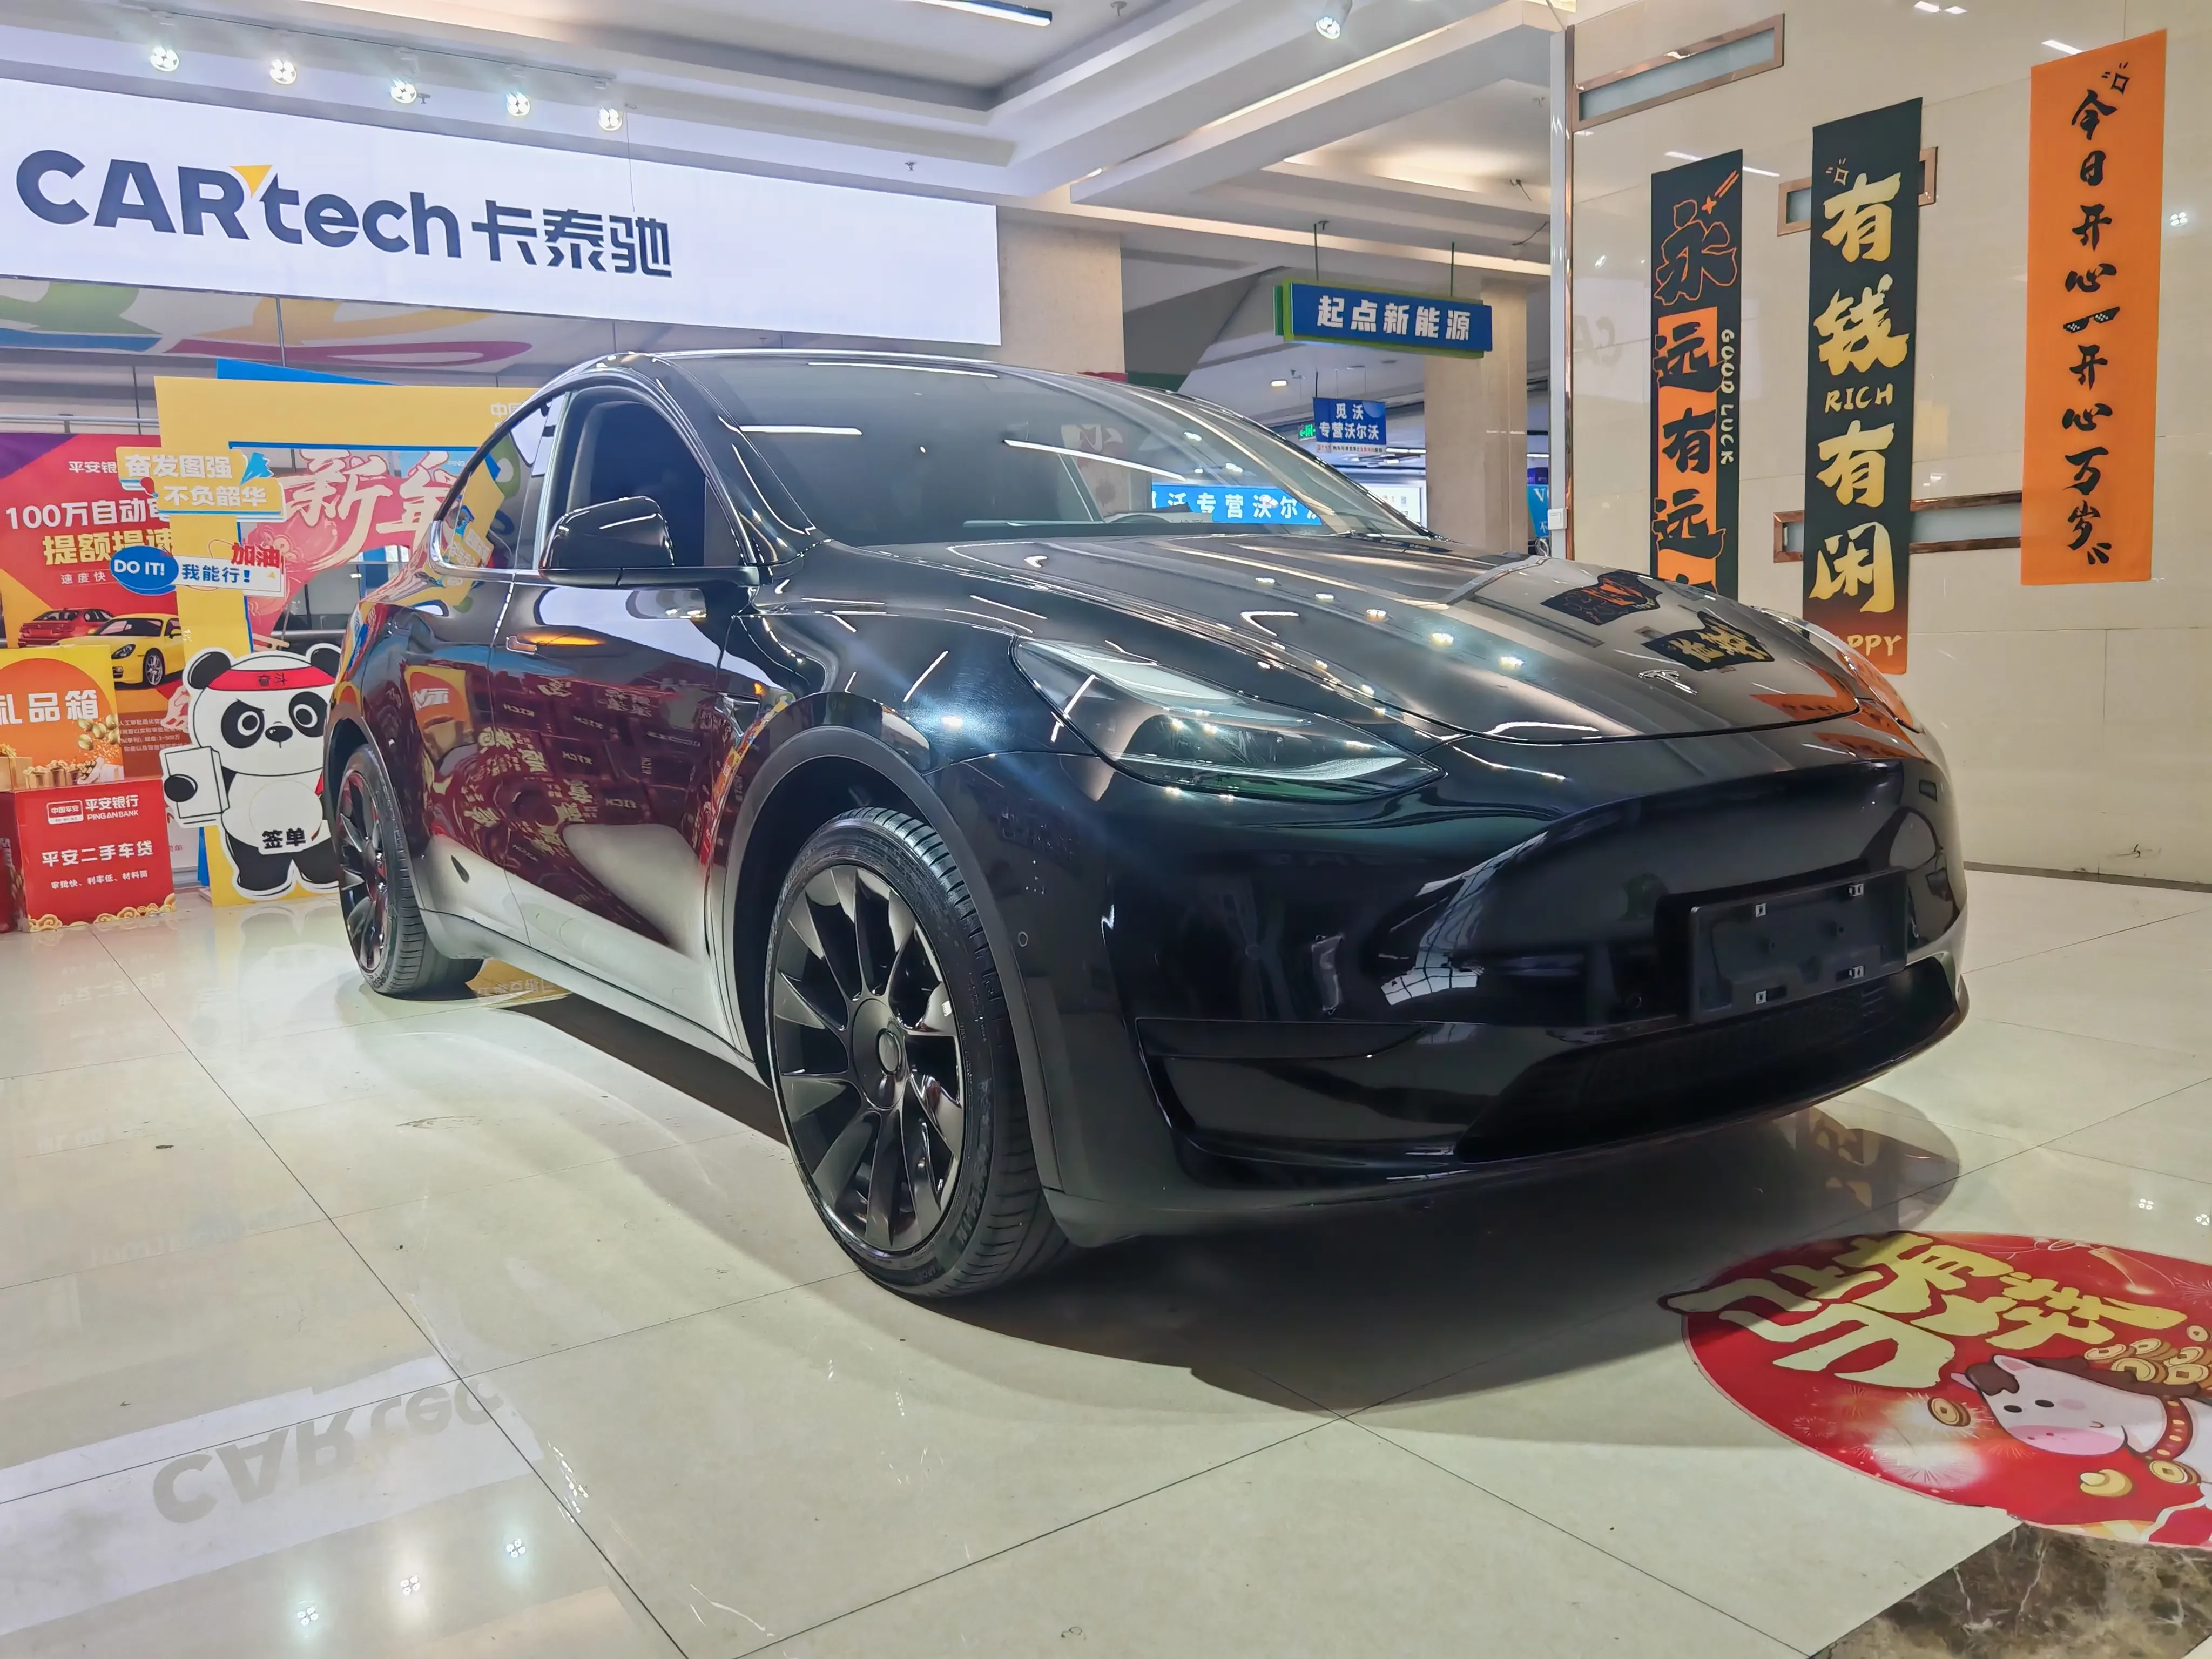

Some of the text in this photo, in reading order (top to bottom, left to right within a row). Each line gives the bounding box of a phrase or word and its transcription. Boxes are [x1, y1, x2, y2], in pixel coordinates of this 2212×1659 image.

[16, 149, 672, 278] CARtech 卡泰驰
[1813, 172, 1910, 376] 有钱
[1317, 295, 1471, 341] 起点新能源
[2062, 89, 2117, 550] 今日开心 开心万岁
[1653, 199, 1737, 594] 永远有远
[1824, 382, 1894, 414] RICH
[1336, 403, 1364, 420] 觅沃
[1319, 421, 1379, 440] 专营沃尔沃
[1720, 404, 1735, 465] LUCK
[125, 454, 232, 479] 奋发图强
[163, 485, 267, 507] 不负韶华
[1809, 420, 1895, 613] 有闲
[114, 559, 165, 576] DO IT!
[231, 542, 280, 569] 加油
[60, 571, 106, 584] 速度快
[0, 689, 99, 725] 礼品箱
[51, 805, 79, 814] 中国平安
[85, 794, 139, 811] 平安银行
[262, 827, 306, 849] 签单
[41, 840, 153, 867] 平安二手车贷
